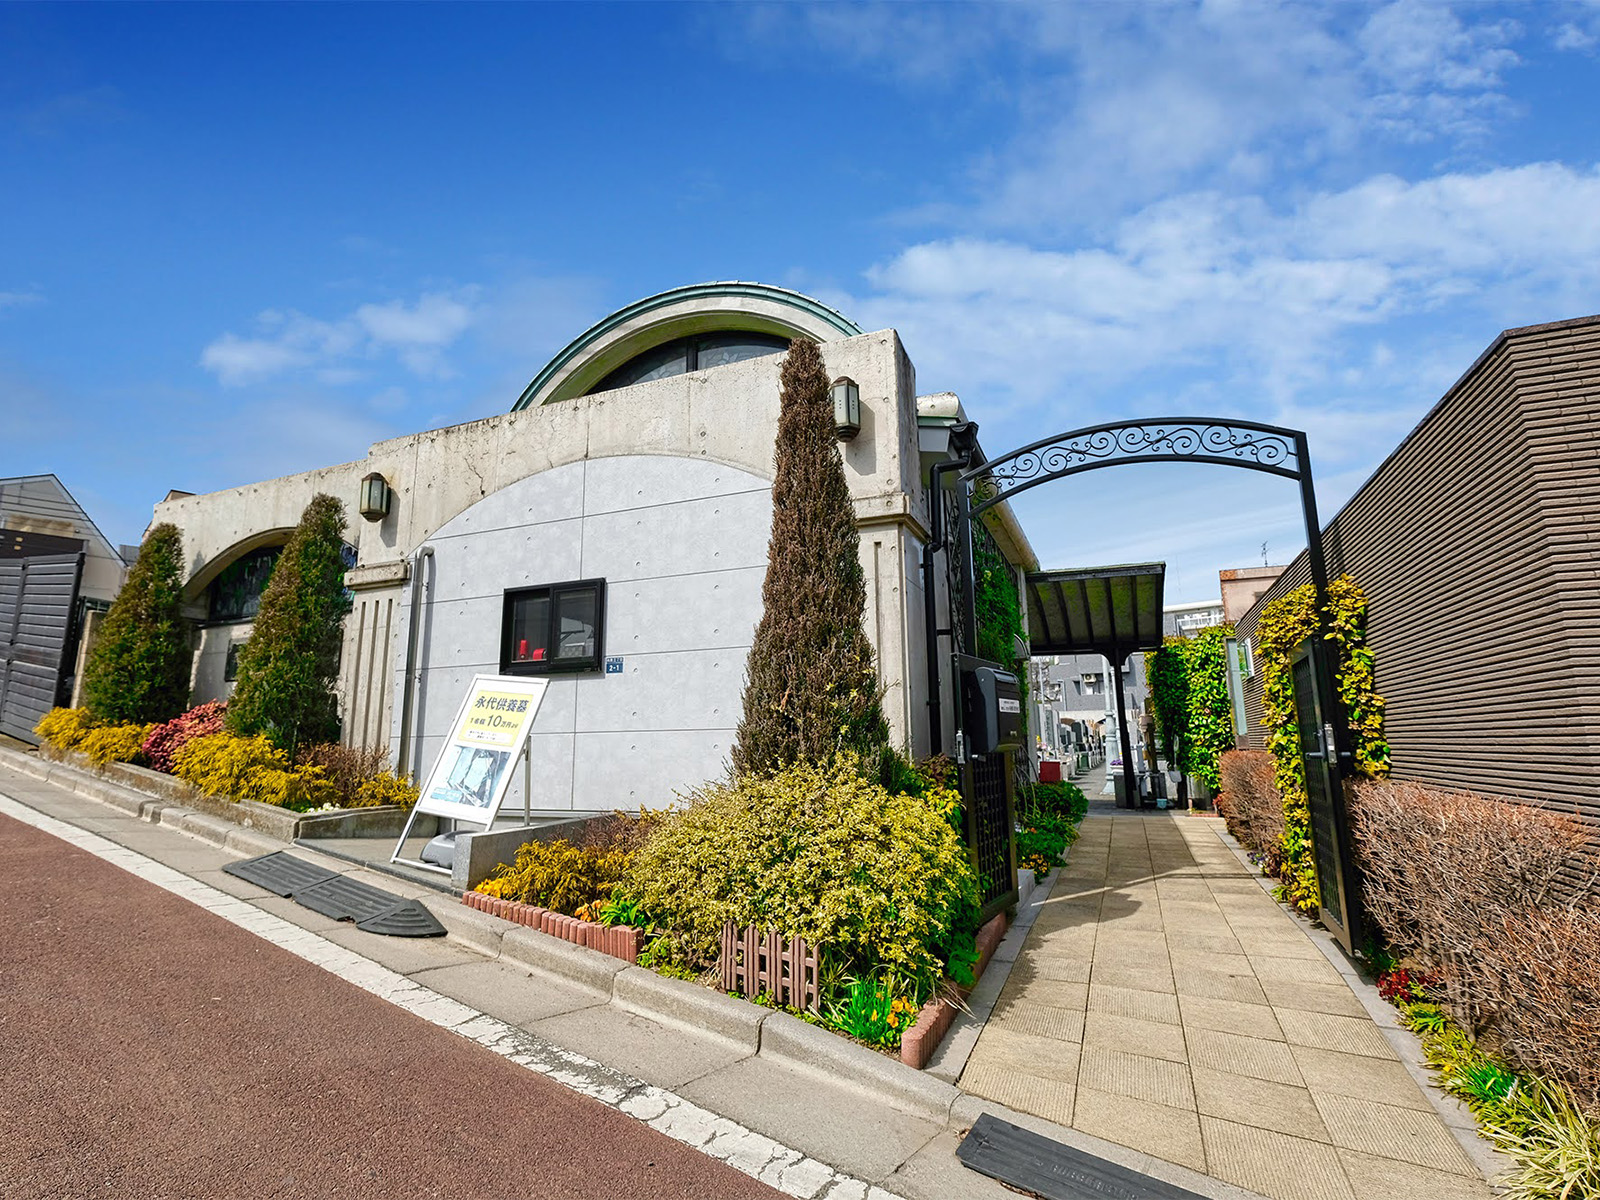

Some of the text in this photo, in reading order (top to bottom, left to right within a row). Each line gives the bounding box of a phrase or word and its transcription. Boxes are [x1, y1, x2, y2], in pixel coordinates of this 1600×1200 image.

[475, 696, 530, 713] 永代供養墓
